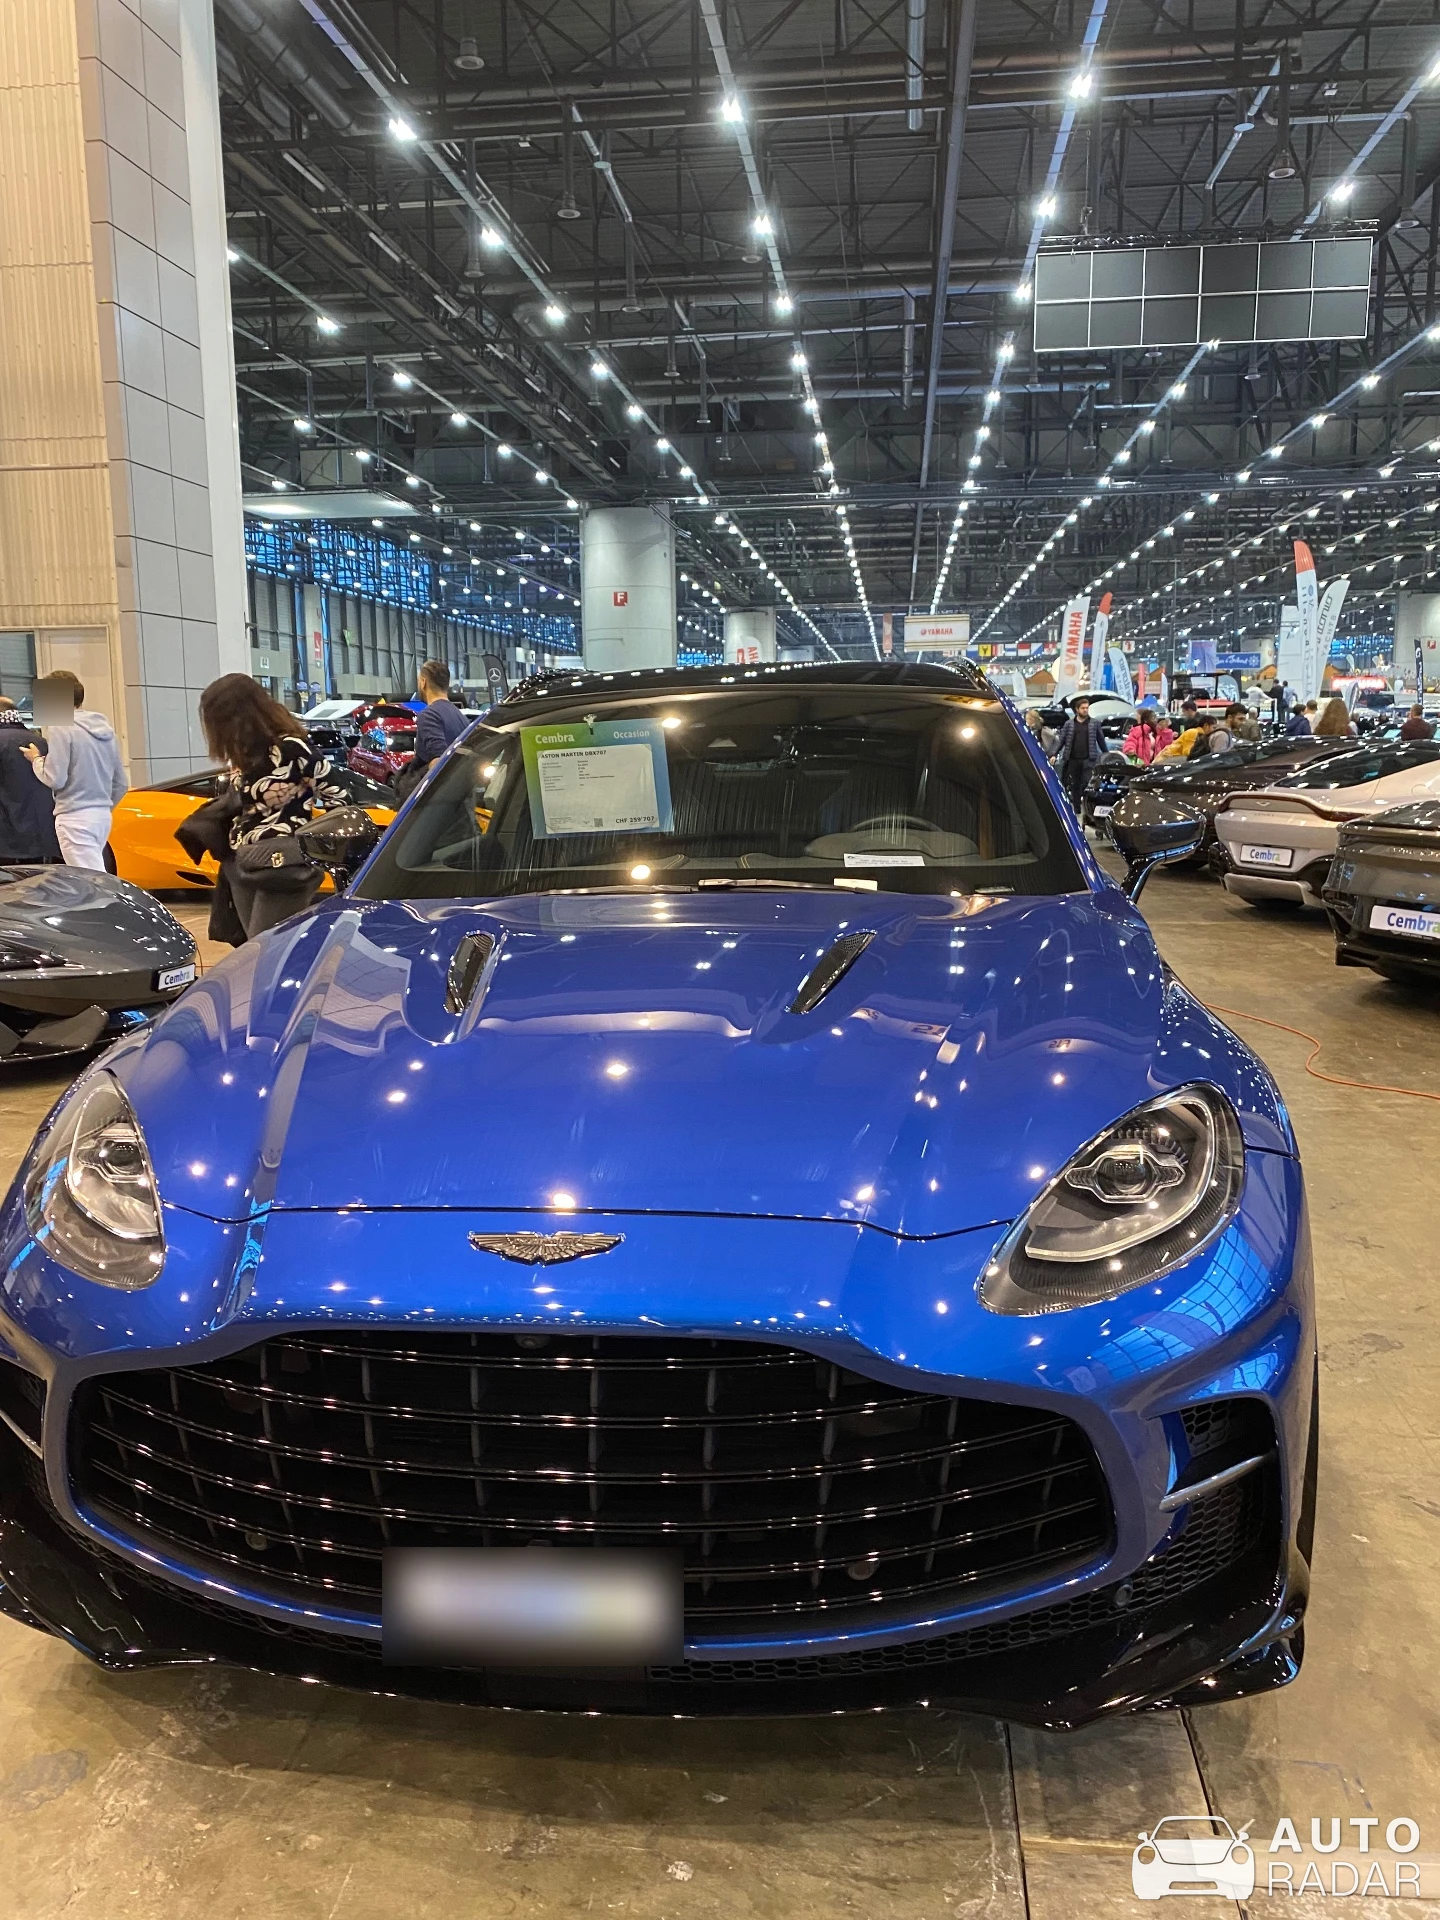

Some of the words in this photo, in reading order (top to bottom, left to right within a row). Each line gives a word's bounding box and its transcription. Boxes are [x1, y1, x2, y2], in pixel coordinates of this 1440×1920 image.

[927, 628, 953, 636] YAMAHA
[1065, 611, 1083, 662] YAMAHA
[535, 733, 575, 744] Cembra
[613, 730, 650, 739] Occasion
[1250, 849, 1281, 862] Cembra
[1387, 912, 1440, 933] Cembra
[164, 970, 190, 986] Cembra
